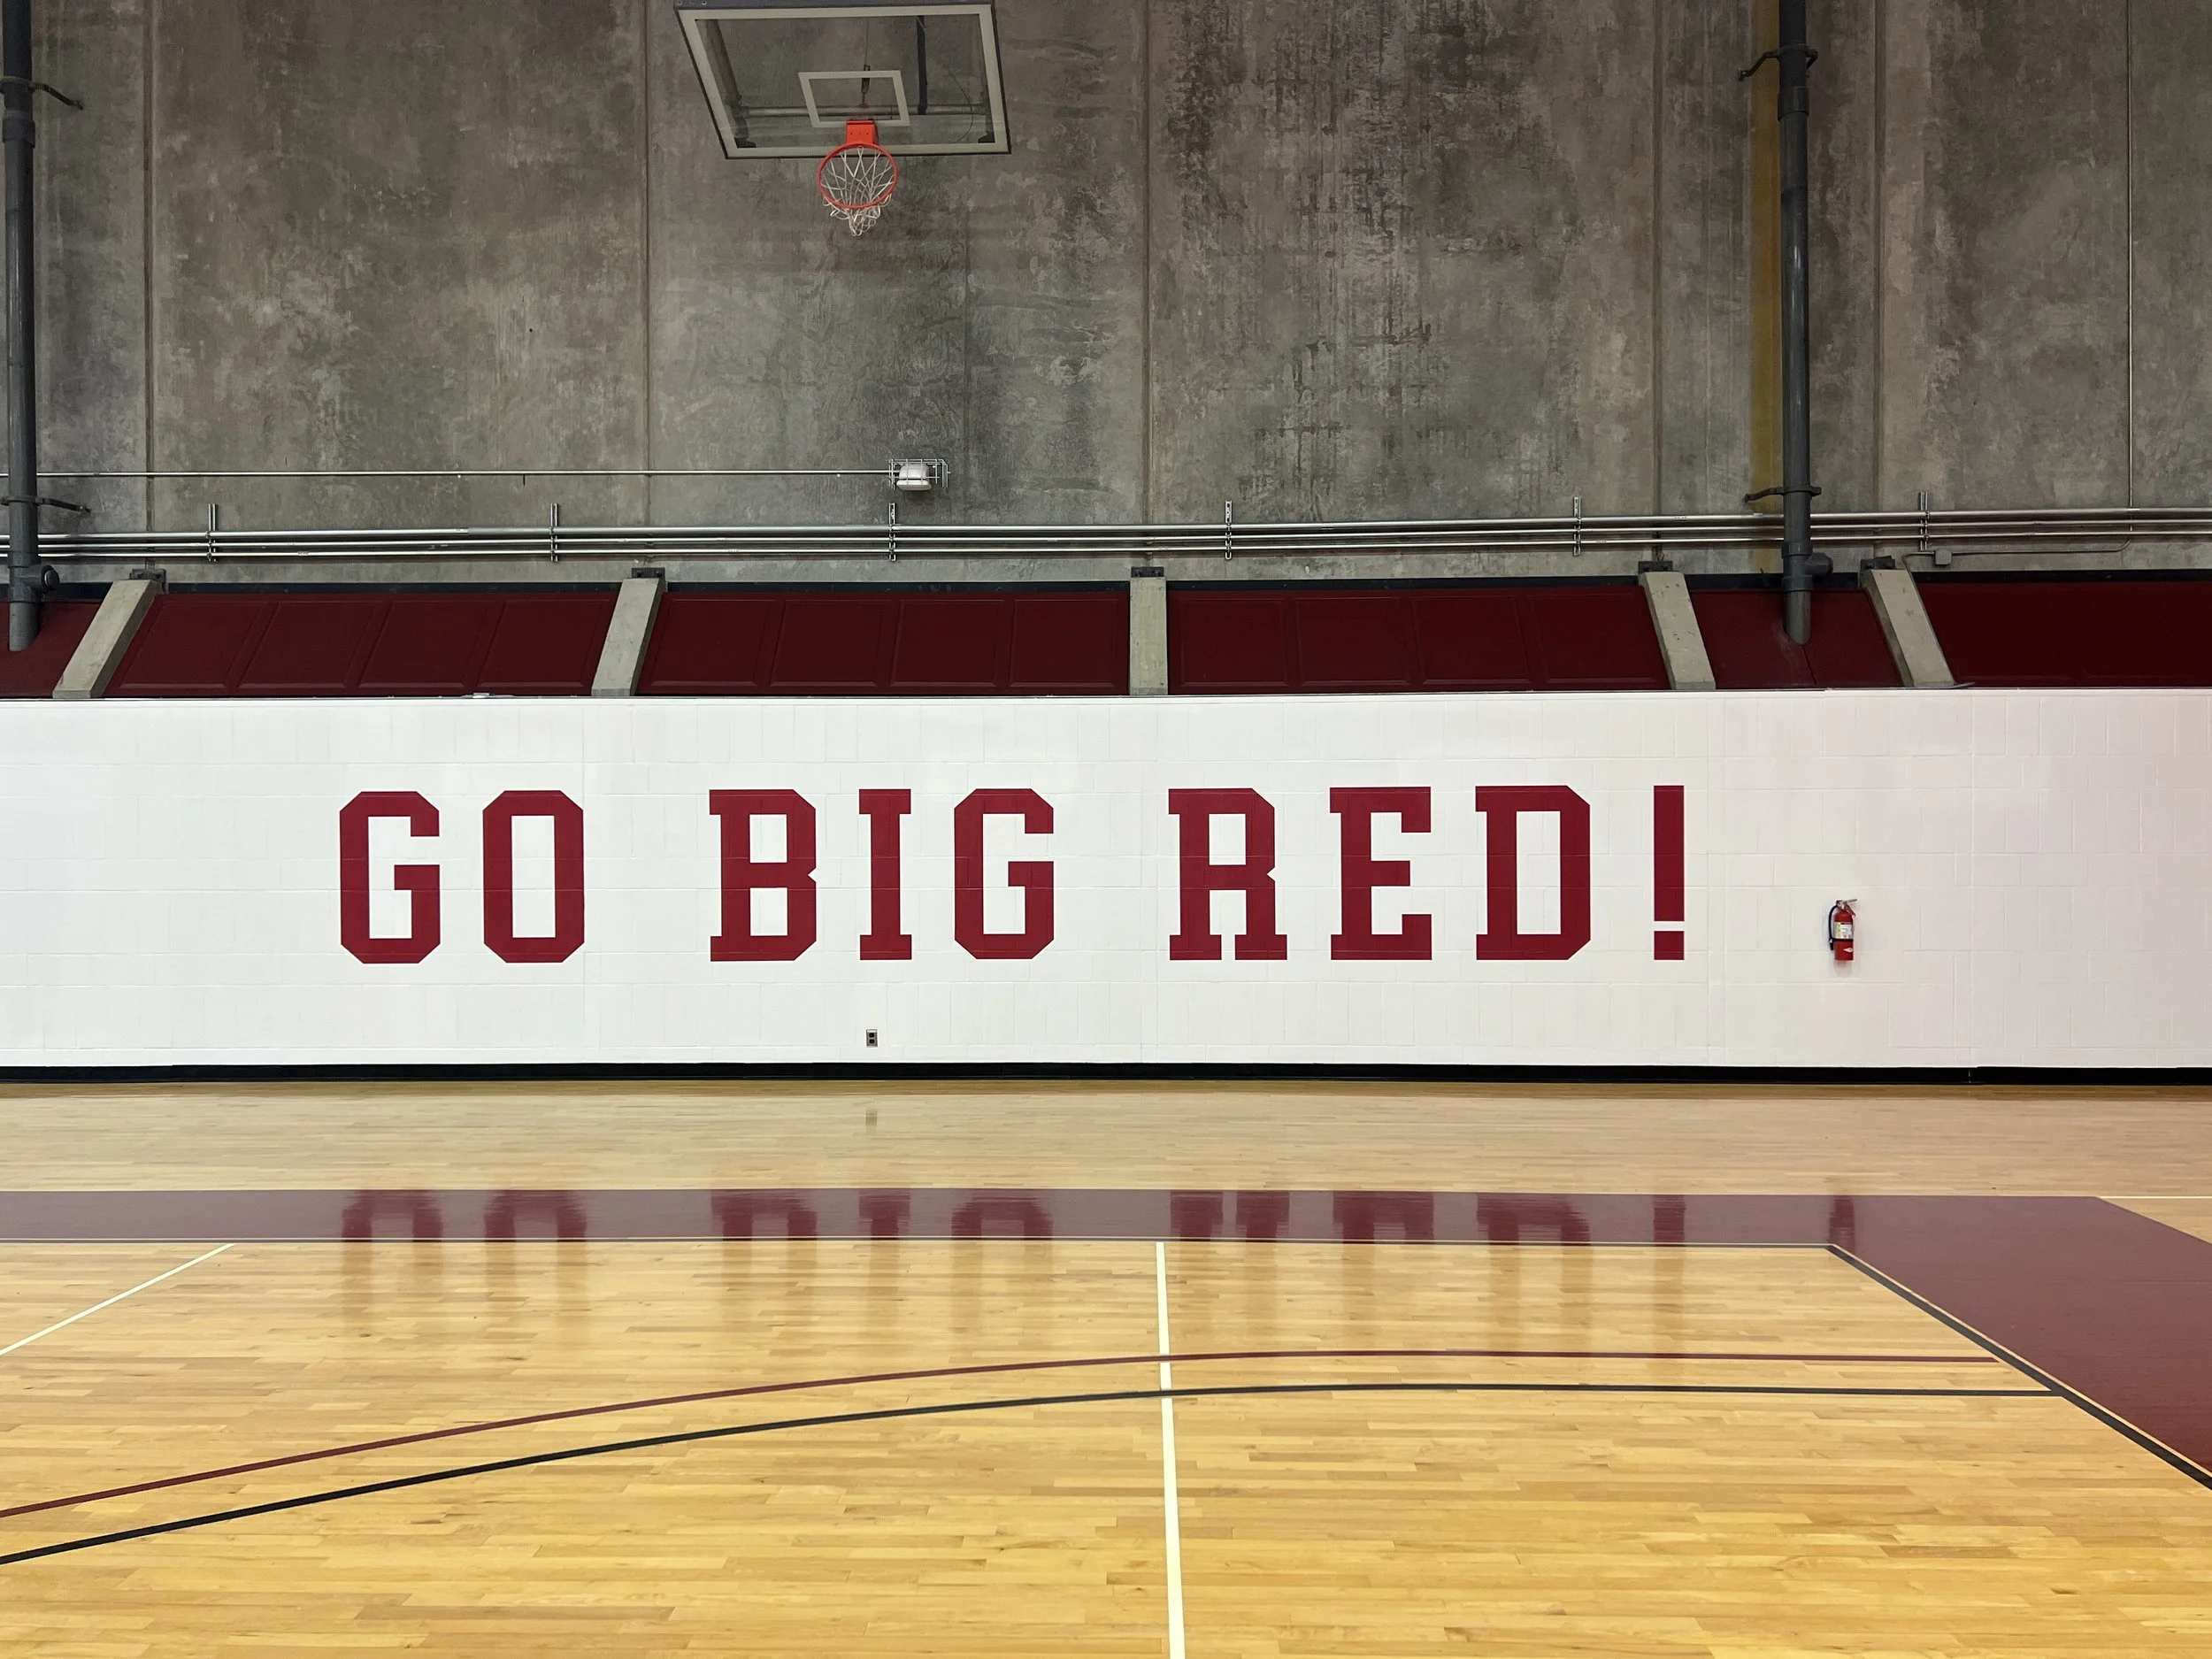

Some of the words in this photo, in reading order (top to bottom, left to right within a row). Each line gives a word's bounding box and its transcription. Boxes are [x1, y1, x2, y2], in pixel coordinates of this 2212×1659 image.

[340, 790, 584, 964] GO
[710, 787, 1054, 962] BIG
[1169, 785, 1685, 960] RED!
